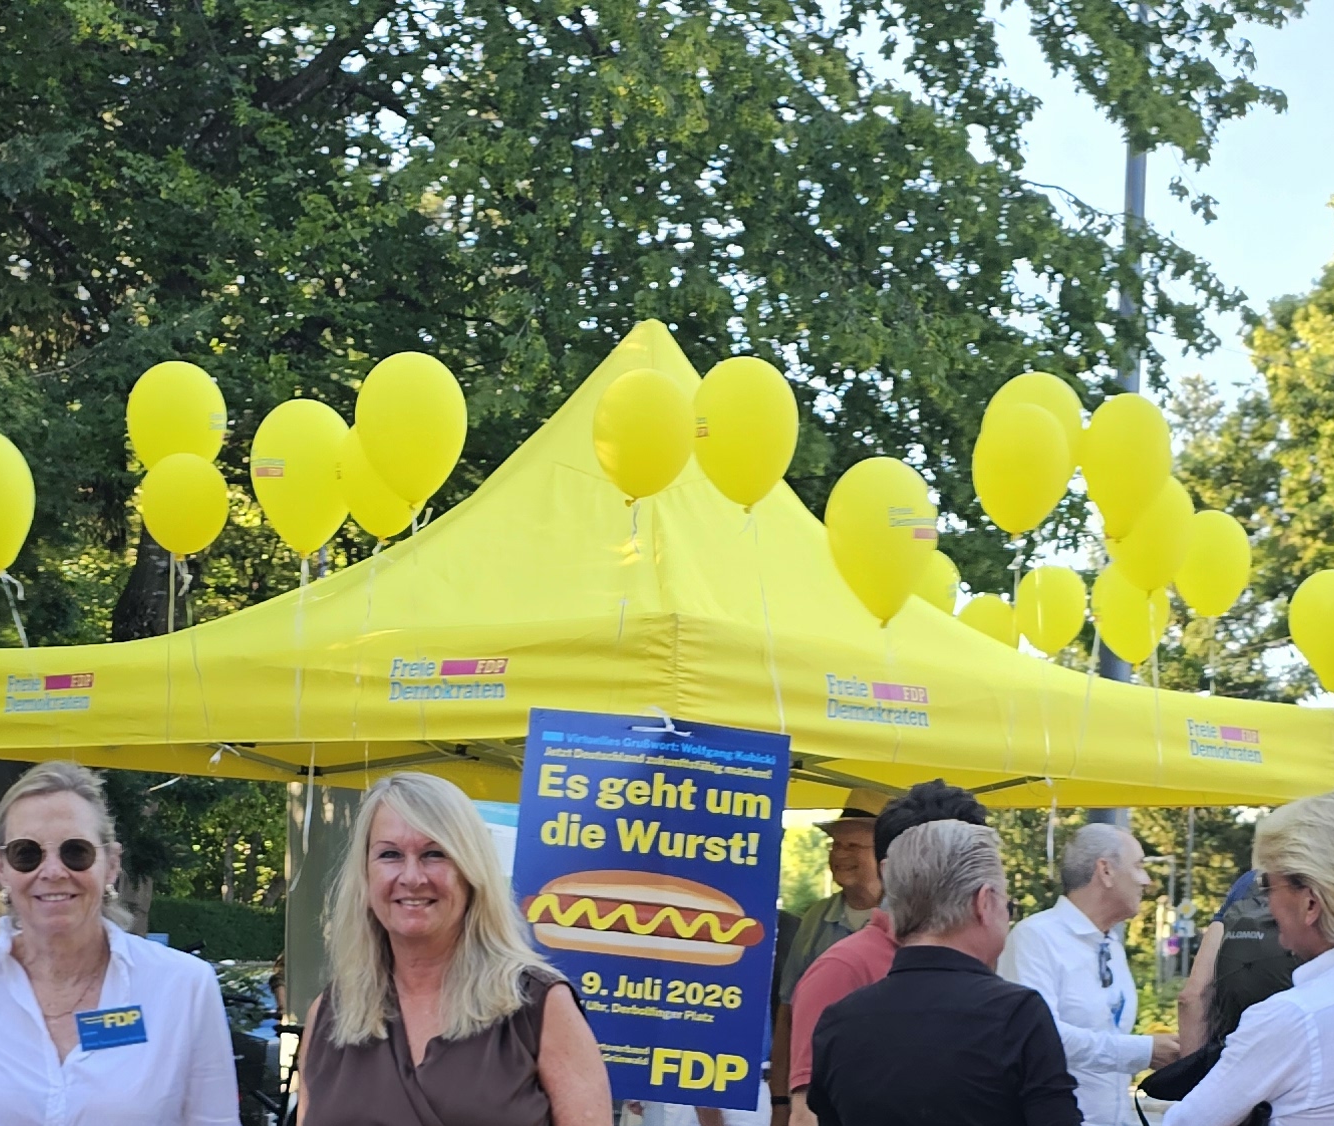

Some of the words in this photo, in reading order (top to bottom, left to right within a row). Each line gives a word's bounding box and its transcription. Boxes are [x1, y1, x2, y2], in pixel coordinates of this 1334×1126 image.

[389, 657, 436, 678] Freie
[475, 659, 507, 674] FDP
[7, 674, 41, 692] Freie
[389, 678, 506, 701] Demokraten
[826, 673, 869, 698] Freie
[902, 686, 926, 702] FDP
[5, 693, 89, 712] Demokraten
[827, 698, 929, 727] Demokraten
[1187, 719, 1217, 739] Freie
[622, 737, 680, 752] Grußwort:
[681, 742, 733, 761] Wolfgang
[1190, 739, 1263, 763] Demokraten
[537, 763, 590, 800] Es
[595, 772, 697, 810] geht
[705, 788, 771, 820] um
[540, 811, 606, 849] die
[616, 818, 760, 866] Wurst!
[1224, 930, 1265, 940] ALOMON
[581, 971, 609, 996] 9.
[613, 975, 663, 1001] Juli
[666, 979, 743, 1009] 2026
[104, 1010, 141, 1028] FDP
[684, 1010, 715, 1022] Platz
[650, 1048, 749, 1092] FDP
